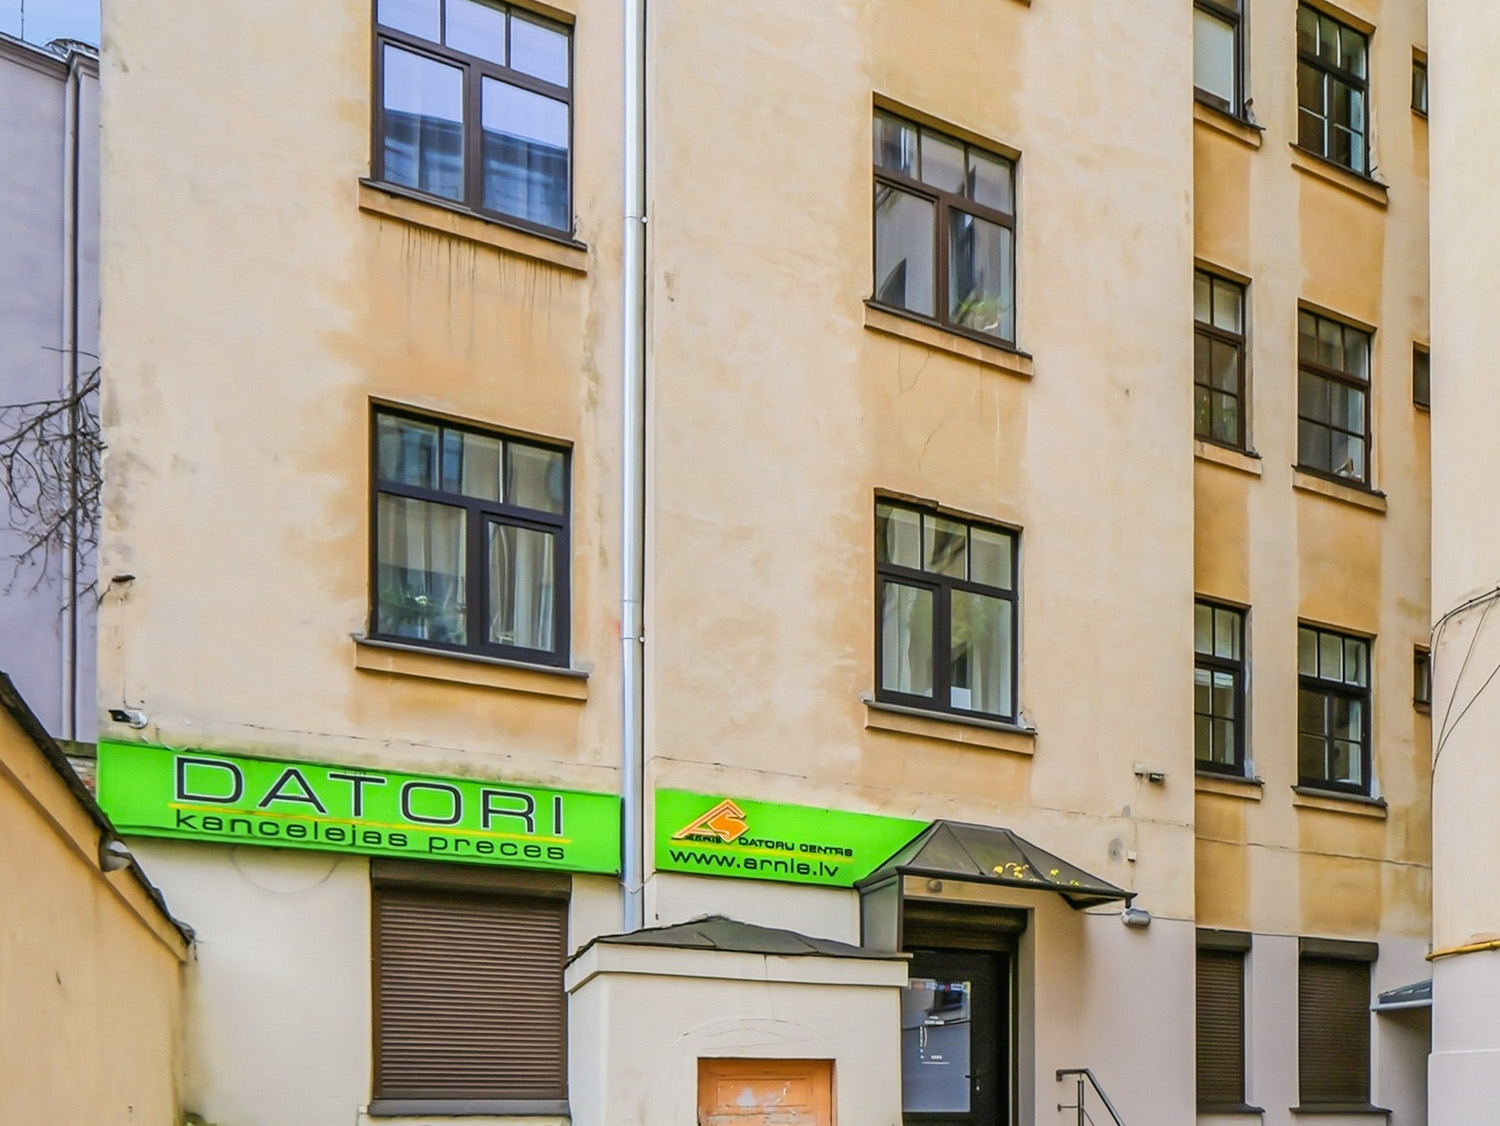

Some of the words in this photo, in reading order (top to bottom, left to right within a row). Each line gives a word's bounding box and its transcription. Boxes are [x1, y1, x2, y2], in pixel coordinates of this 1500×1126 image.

[174, 755, 564, 836] DATORI
[176, 808, 408, 847] kancelejas
[428, 836, 566, 860] preces
[738, 837, 795, 851] DATORU
